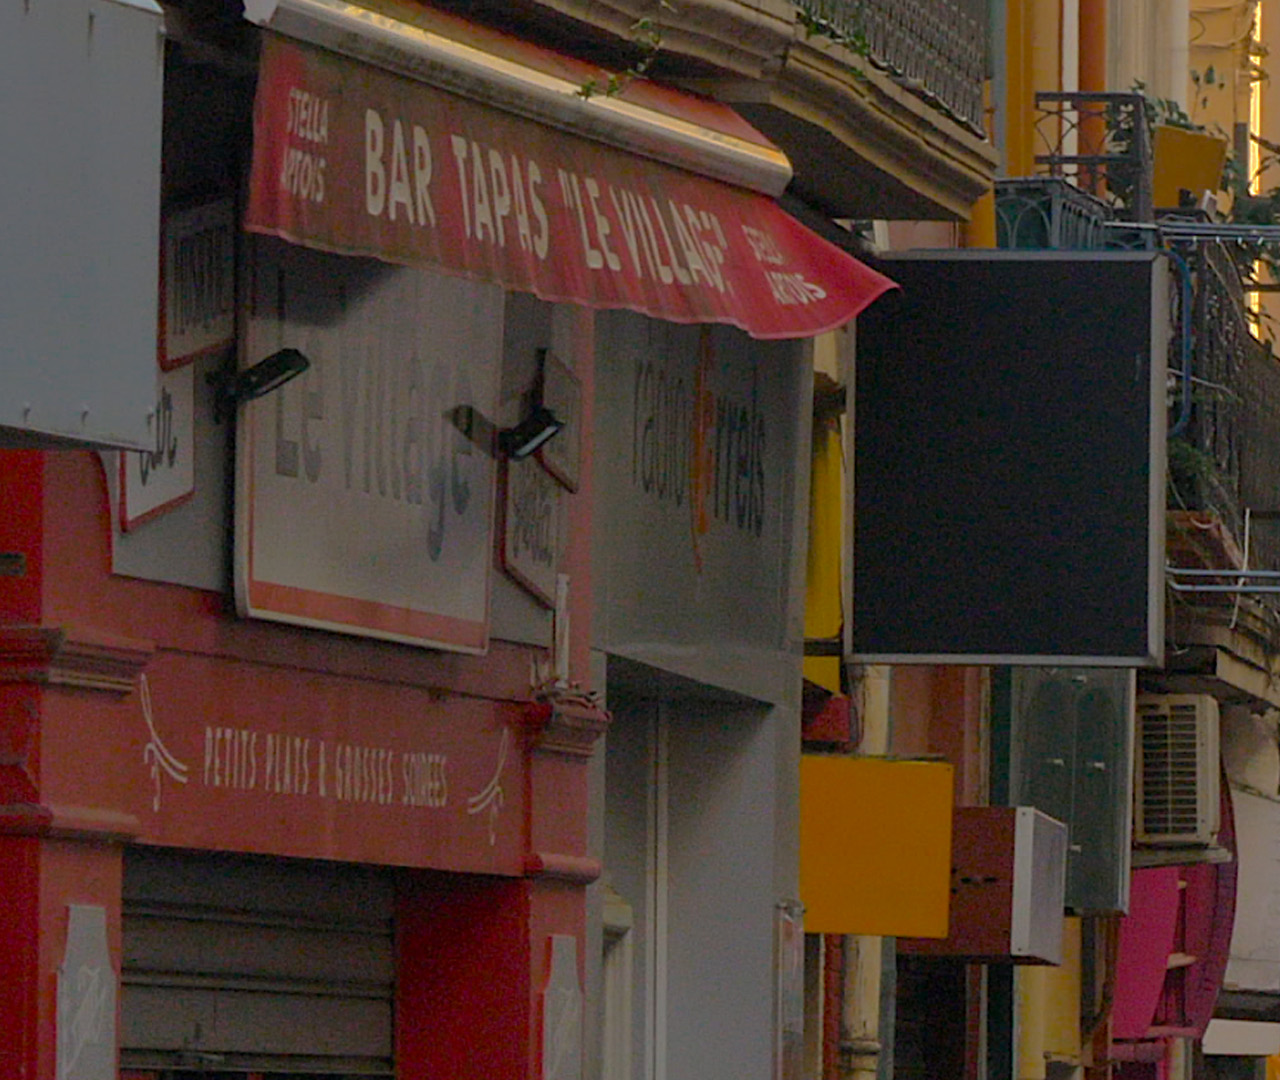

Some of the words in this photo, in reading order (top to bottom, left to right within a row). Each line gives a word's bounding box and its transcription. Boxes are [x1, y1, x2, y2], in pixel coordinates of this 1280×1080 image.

[286, 86, 329, 146] STELLA
[365, 108, 437, 230] BAR
[451, 133, 550, 261] TAPAS
[203, 725, 257, 789] PETITS
[265, 732, 310, 796] PLATS
[335, 743, 394, 805] GROSSES
